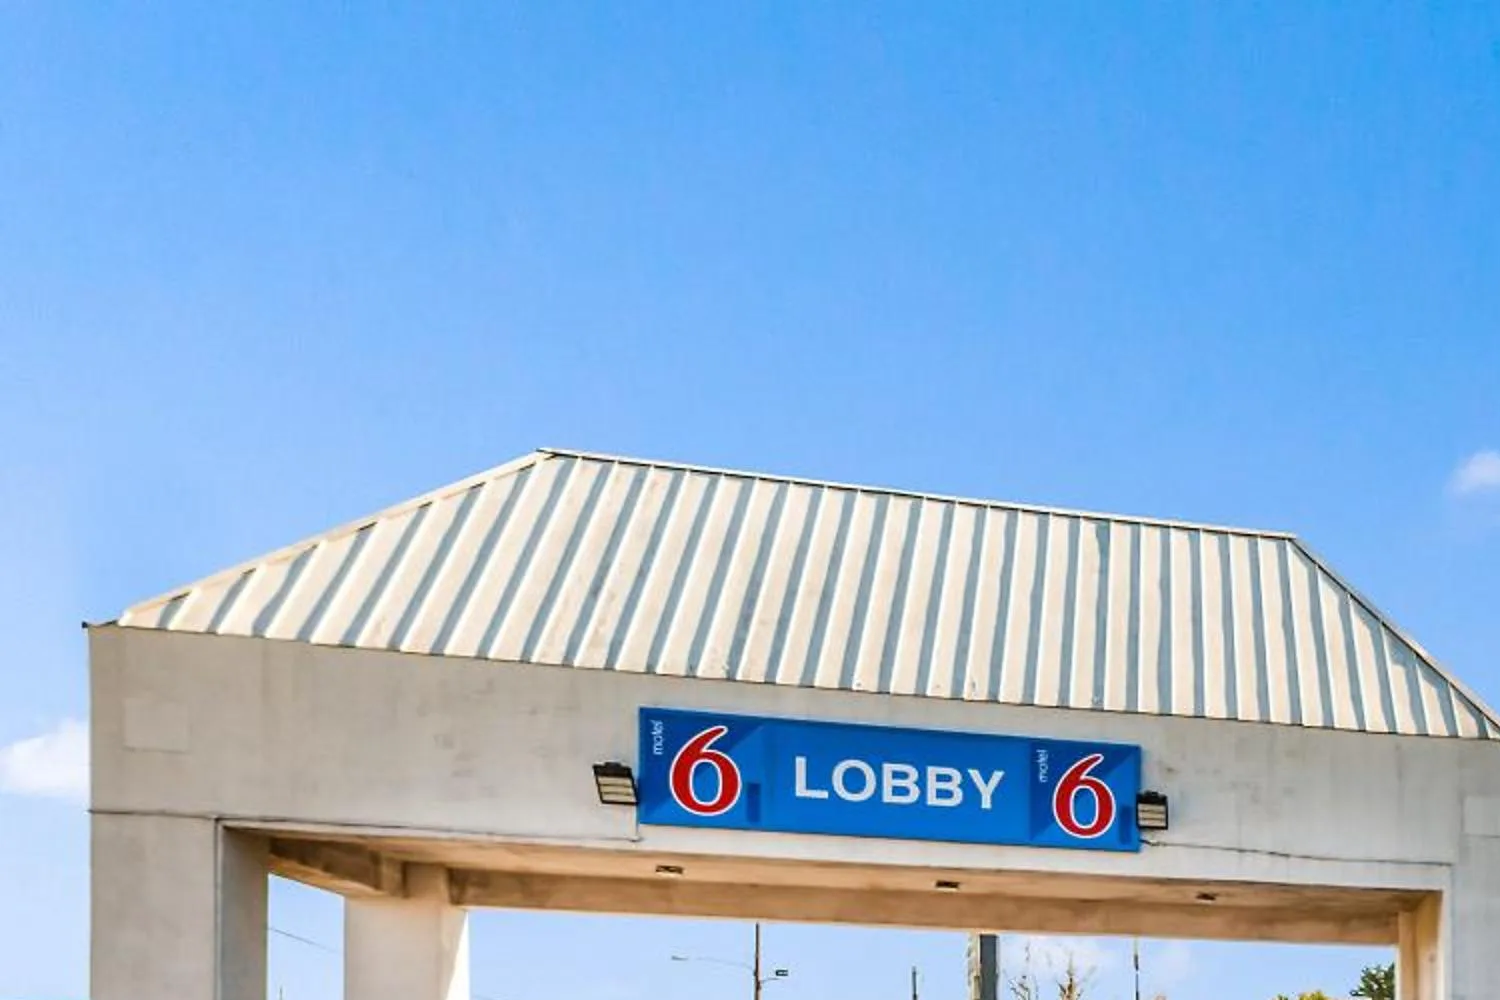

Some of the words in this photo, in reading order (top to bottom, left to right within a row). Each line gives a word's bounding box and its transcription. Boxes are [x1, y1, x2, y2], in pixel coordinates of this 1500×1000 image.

[651, 719, 664, 755] motel
[669, 725, 742, 816] 6
[795, 756, 1005, 809] LOBBY
[1036, 748, 1049, 783] motel
[1052, 753, 1116, 839] 6
